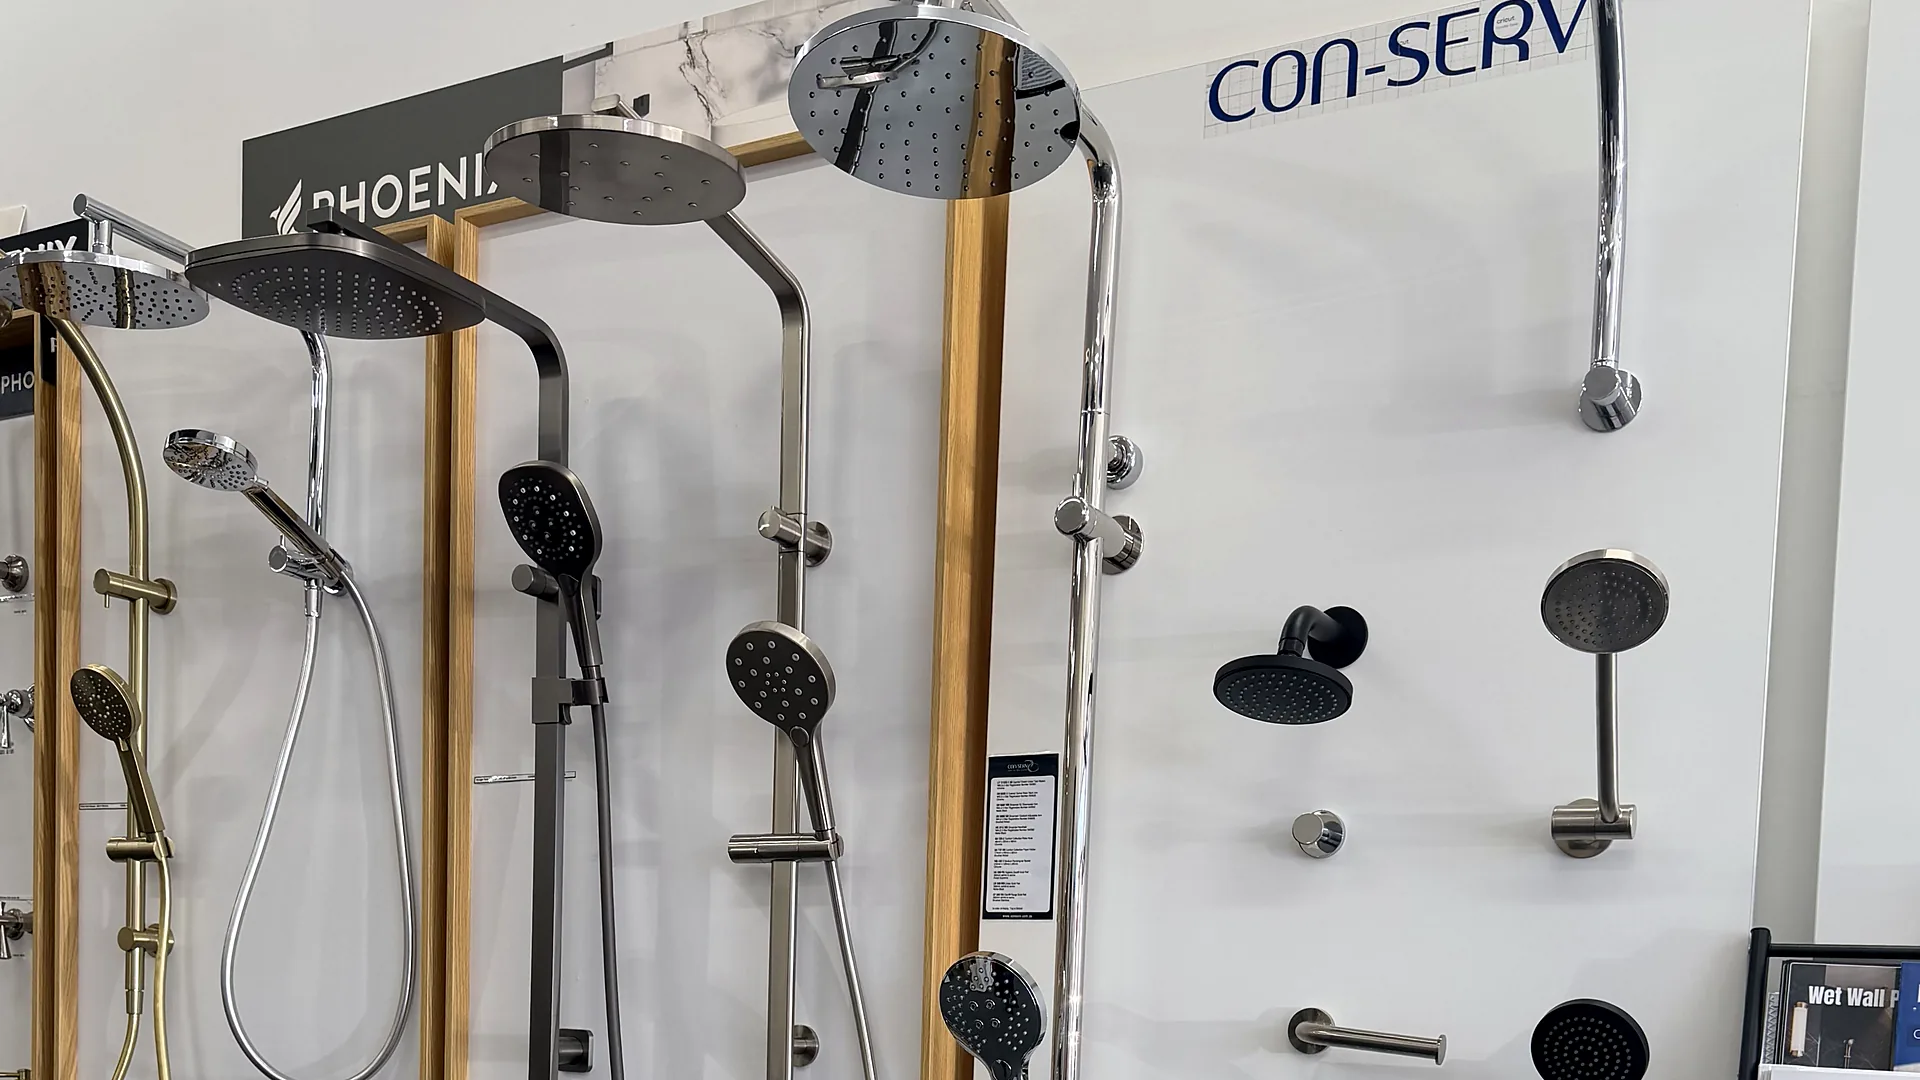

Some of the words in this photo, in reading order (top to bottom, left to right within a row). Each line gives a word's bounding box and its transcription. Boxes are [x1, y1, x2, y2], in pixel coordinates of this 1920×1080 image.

[313, 152, 498, 232] PHOENI
[1808, 985, 1842, 1006] Wet
[1847, 987, 1885, 1008] Wall
